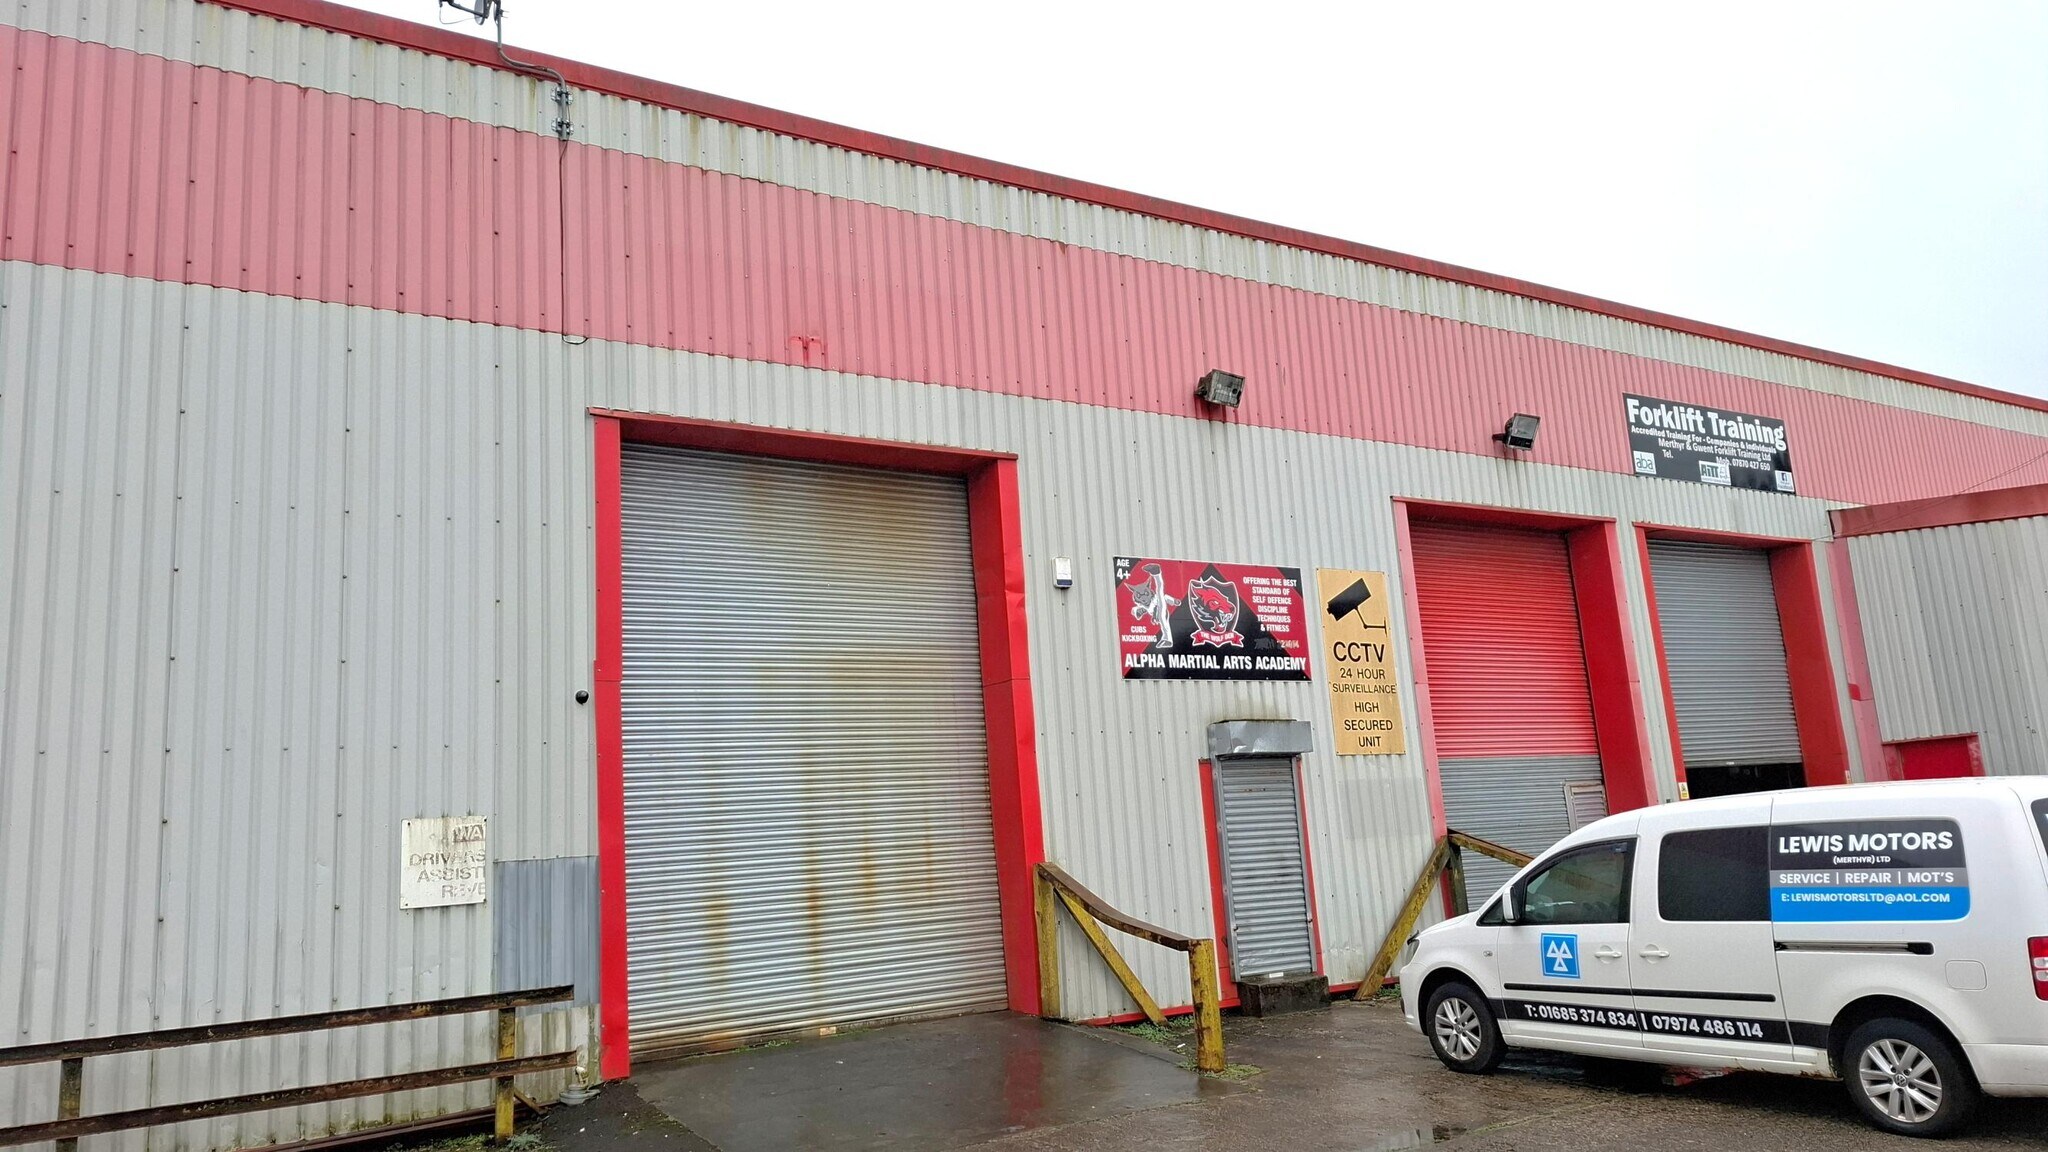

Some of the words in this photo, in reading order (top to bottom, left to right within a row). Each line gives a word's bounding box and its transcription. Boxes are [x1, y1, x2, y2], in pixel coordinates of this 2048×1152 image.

[1626, 398, 1706, 434] Forklift
[1708, 411, 1786, 451] Training
[1631, 425, 1666, 438] Accredited
[1666, 431, 1692, 443] Training
[1692, 434, 1702, 443] For
[1706, 436, 1739, 448] Companies
[1746, 442, 1776, 454] Individuals
[1658, 438, 1685, 451] Merthyr
[1686, 442, 1692, 451] &
[1692, 444, 1714, 454] Gwent
[1714, 446, 1737, 456] Forklift
[1737, 449, 1761, 461] Training
[1762, 453, 1771, 461] Ltd
[1662, 450, 1674, 458] Tel.
[1732, 459, 1749, 468] 07870
[1116, 559, 1130, 567] AGE
[1116, 568, 1131, 580] 4+
[1243, 577, 1270, 585] OFFERING
[1284, 579, 1297, 587] BEST
[1252, 587, 1281, 595] STANDARD
[1258, 606, 1288, 614] DISCIPLINE
[1257, 614, 1291, 623] TECHNIQUES
[1266, 624, 1290, 632] FITNESS
[1122, 634, 1157, 643] KICKBOXING
[1333, 641, 1385, 663] CCTV
[1125, 654, 1166, 668] ALPHA
[1168, 654, 1220, 669] MARTIAL
[1223, 656, 1252, 670] ARTS
[1255, 656, 1307, 671] ACADEMY
[1340, 668, 1352, 679] 24
[1357, 669, 1386, 680] HOUR
[1332, 683, 1397, 694] SURVEILLANCE
[1354, 702, 1379, 713] HIGH
[1344, 719, 1393, 731] SECURED
[1358, 736, 1381, 747] UNIT
[454, 824, 485, 841] WA
[1779, 835, 1843, 854] LEWIS
[1849, 831, 1953, 852] MOTORS
[1833, 855, 1875, 865] (MERTHYR)
[1779, 873, 1830, 884] SERVICE
[1845, 872, 1891, 883] REPAIR
[1908, 871, 1954, 883] MOT'S
[1781, 893, 1790, 902] E:
[1791, 893, 1950, 903] LEWISMOTORSLTD@AOL.COM
[1524, 1004, 1538, 1018] T:
[1539, 1005, 1578, 1020] 01685
[1580, 1009, 1606, 1025] 374
[1609, 1012, 1636, 1027] 834
[1652, 1015, 1700, 1033] 07974
[1703, 1020, 1734, 1036] 486
[1736, 1021, 1763, 1038] 114
